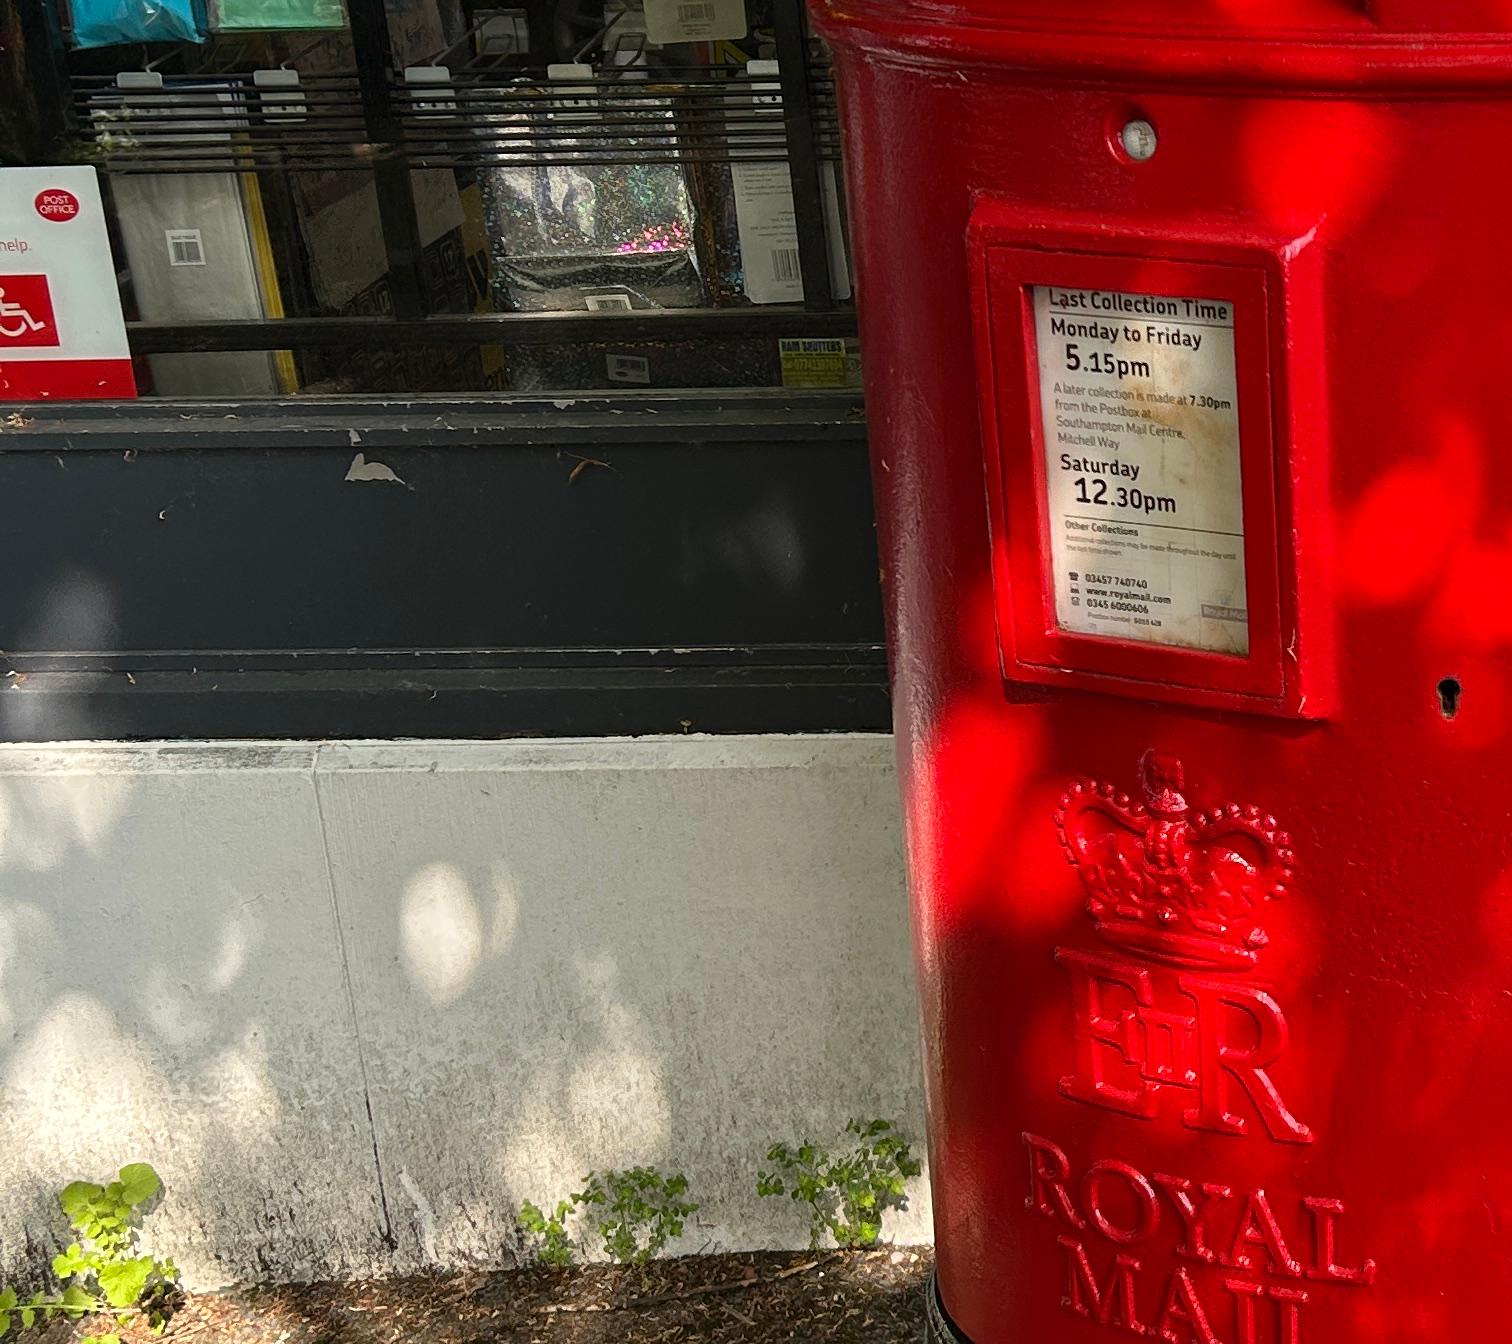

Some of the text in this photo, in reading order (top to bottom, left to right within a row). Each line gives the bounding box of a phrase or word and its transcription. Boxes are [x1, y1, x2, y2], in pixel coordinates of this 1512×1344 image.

[40, 205, 75, 214] OFFICE
[43, 195, 69, 204] POST
[1050, 288, 1227, 320] Last Collection Time
[1051, 317, 1202, 351] Monday to Friday
[1065, 343, 1151, 379] 5.15pm
[1053, 382, 1231, 410] A later collection is made at 7.30pm
[1055, 398, 1151, 419] from the Postbox at
[1056, 414, 1125, 433] Southampton
[1126, 422, 1147, 436] Mail
[1057, 432, 1121, 451] Mitchell Way
[1061, 454, 1140, 481] Saturday
[1074, 477, 1176, 514] 12.30pm
[1065, 520, 1139, 537] Other Collections
[1085, 573, 1148, 589] 03457 740740
[1086, 588, 1171, 605] www.royalmail.com
[1087, 598, 1149, 614] 0345 6000606
[1021, 1130, 1377, 1285] ROYAL
